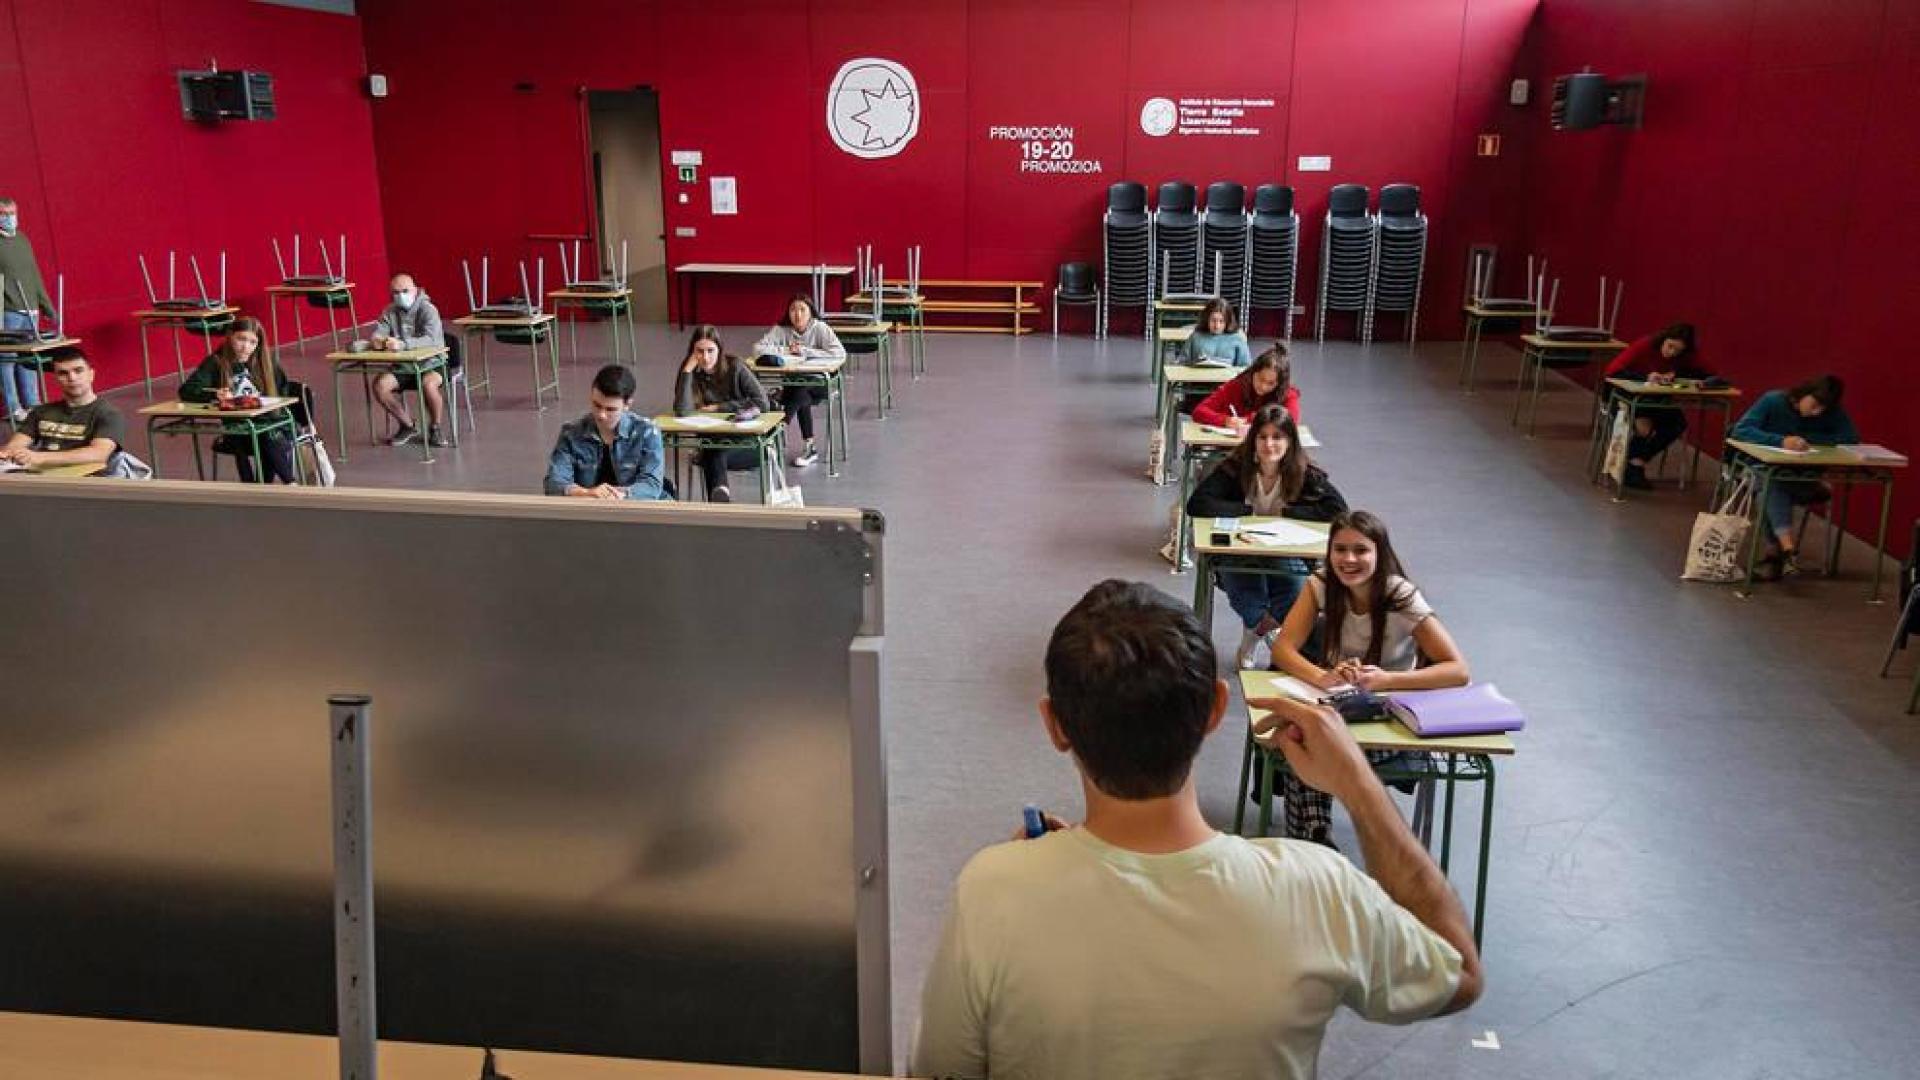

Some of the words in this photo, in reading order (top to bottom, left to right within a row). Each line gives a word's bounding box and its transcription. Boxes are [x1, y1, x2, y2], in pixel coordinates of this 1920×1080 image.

[990, 124, 1073, 140] PROMOCIÓN
[1021, 140, 1074, 160] 19-20
[1021, 160, 1102, 173] PROMOZIOA
